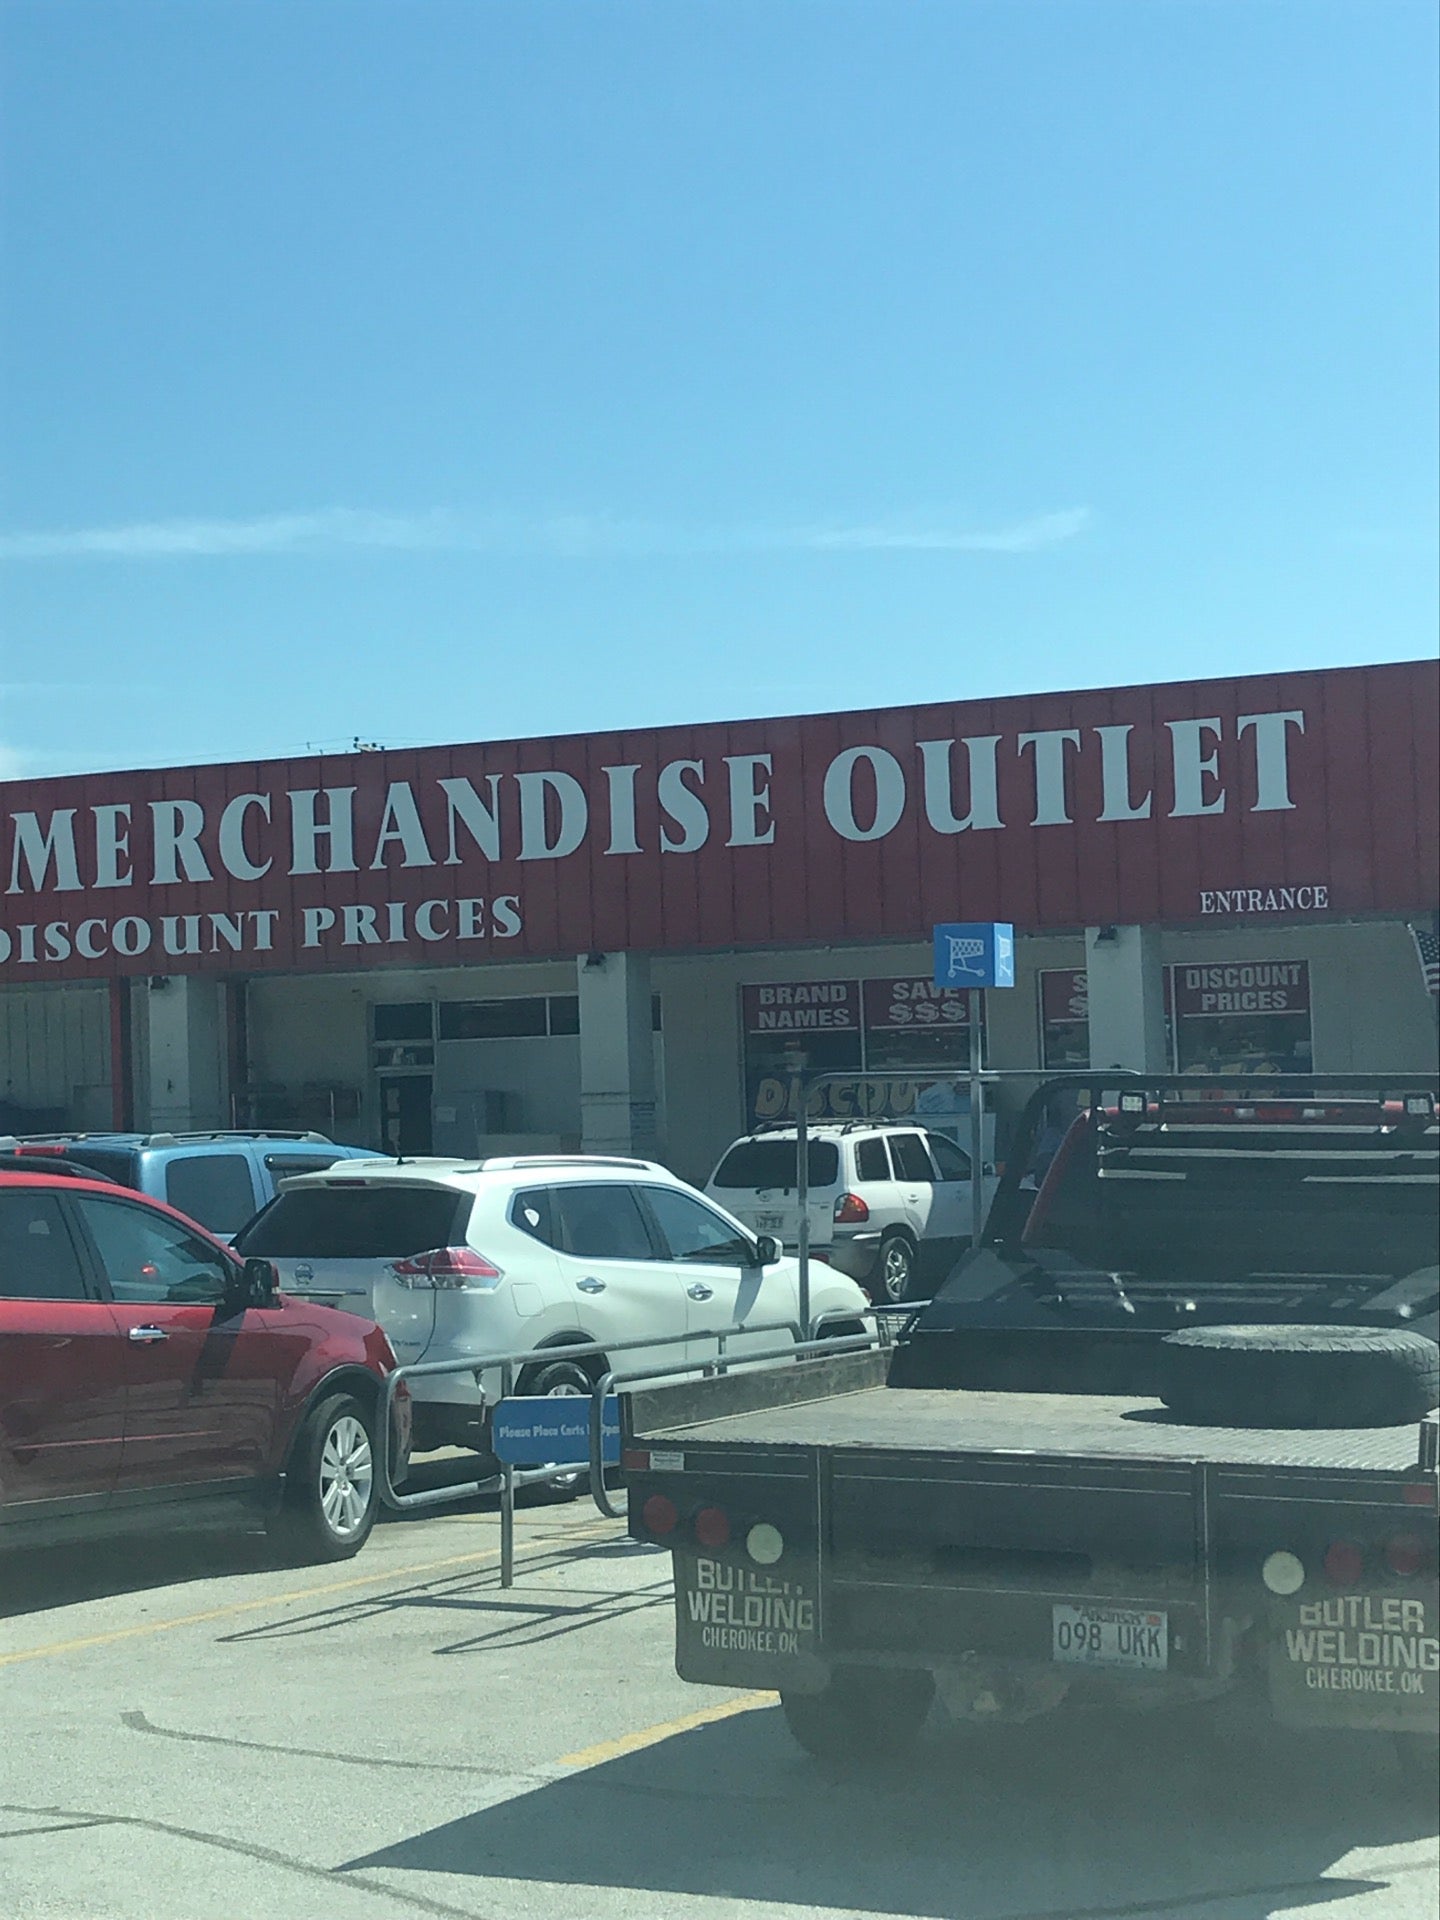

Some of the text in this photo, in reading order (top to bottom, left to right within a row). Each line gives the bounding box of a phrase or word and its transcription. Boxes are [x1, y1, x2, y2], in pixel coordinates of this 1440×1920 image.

[4, 709, 1305, 895] MERCHANDISE OUTLET
[1200, 885, 1329, 914] ENTRANCE
[301, 895, 523, 949] PRICES
[1186, 964, 1301, 990] DISCOUNT
[759, 984, 848, 1005] BRAND
[1201, 990, 1288, 1012] PRICES
[758, 1008, 850, 1029] NAMES
[888, 1001, 967, 1024] $$$
[499, 1425, 531, 1438] Please
[560, 1423, 584, 1436] Carts
[687, 1591, 814, 1630] WELDING
[1300, 1596, 1425, 1633] BUTLER
[778, 1634, 799, 1654] OK
[1058, 1621, 1161, 1658] 098 UKK
[1285, 1629, 1440, 1671] WELDING
[1400, 1671, 1425, 1694] OK
